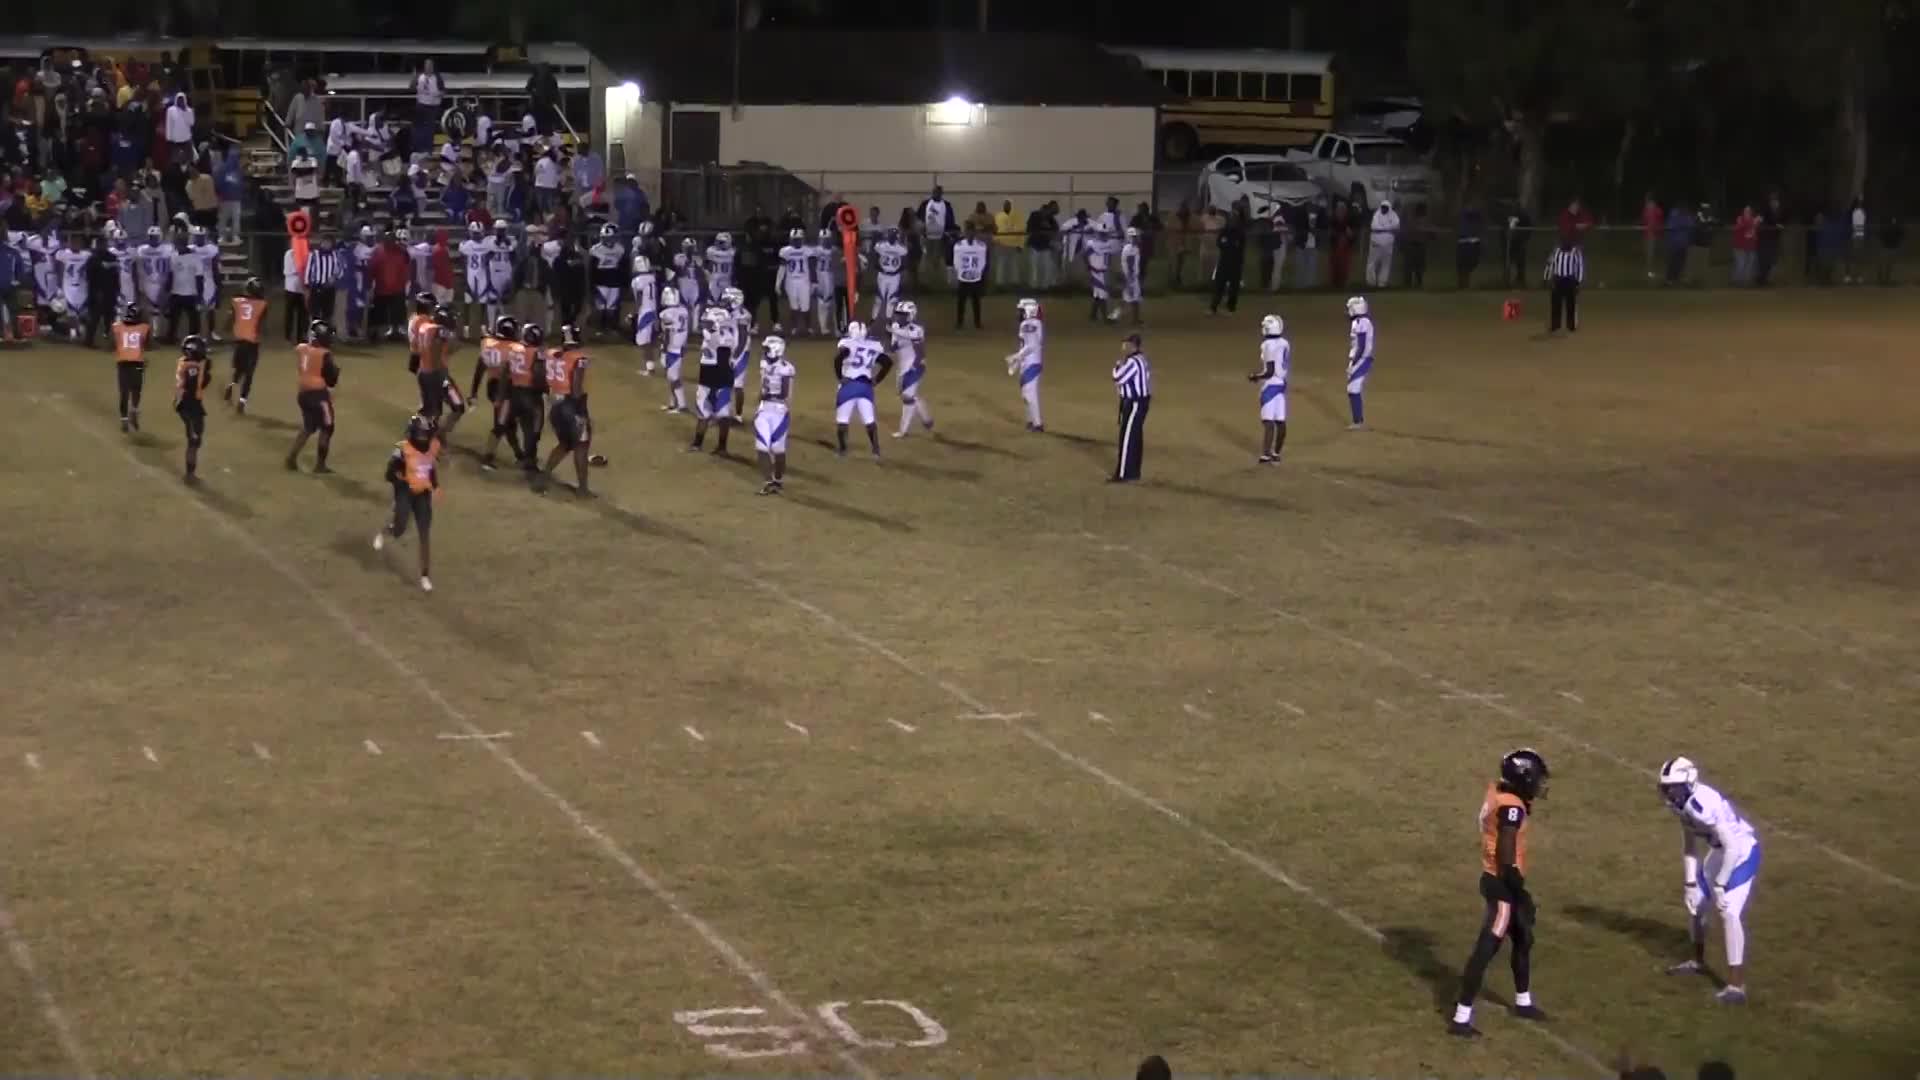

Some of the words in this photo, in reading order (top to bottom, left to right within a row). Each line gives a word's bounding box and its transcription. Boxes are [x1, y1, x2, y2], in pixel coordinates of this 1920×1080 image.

[241, 303, 254, 320] 3
[852, 347, 879, 369] 57
[1507, 806, 1519, 822] 8
[672, 998, 948, 1058] 50
